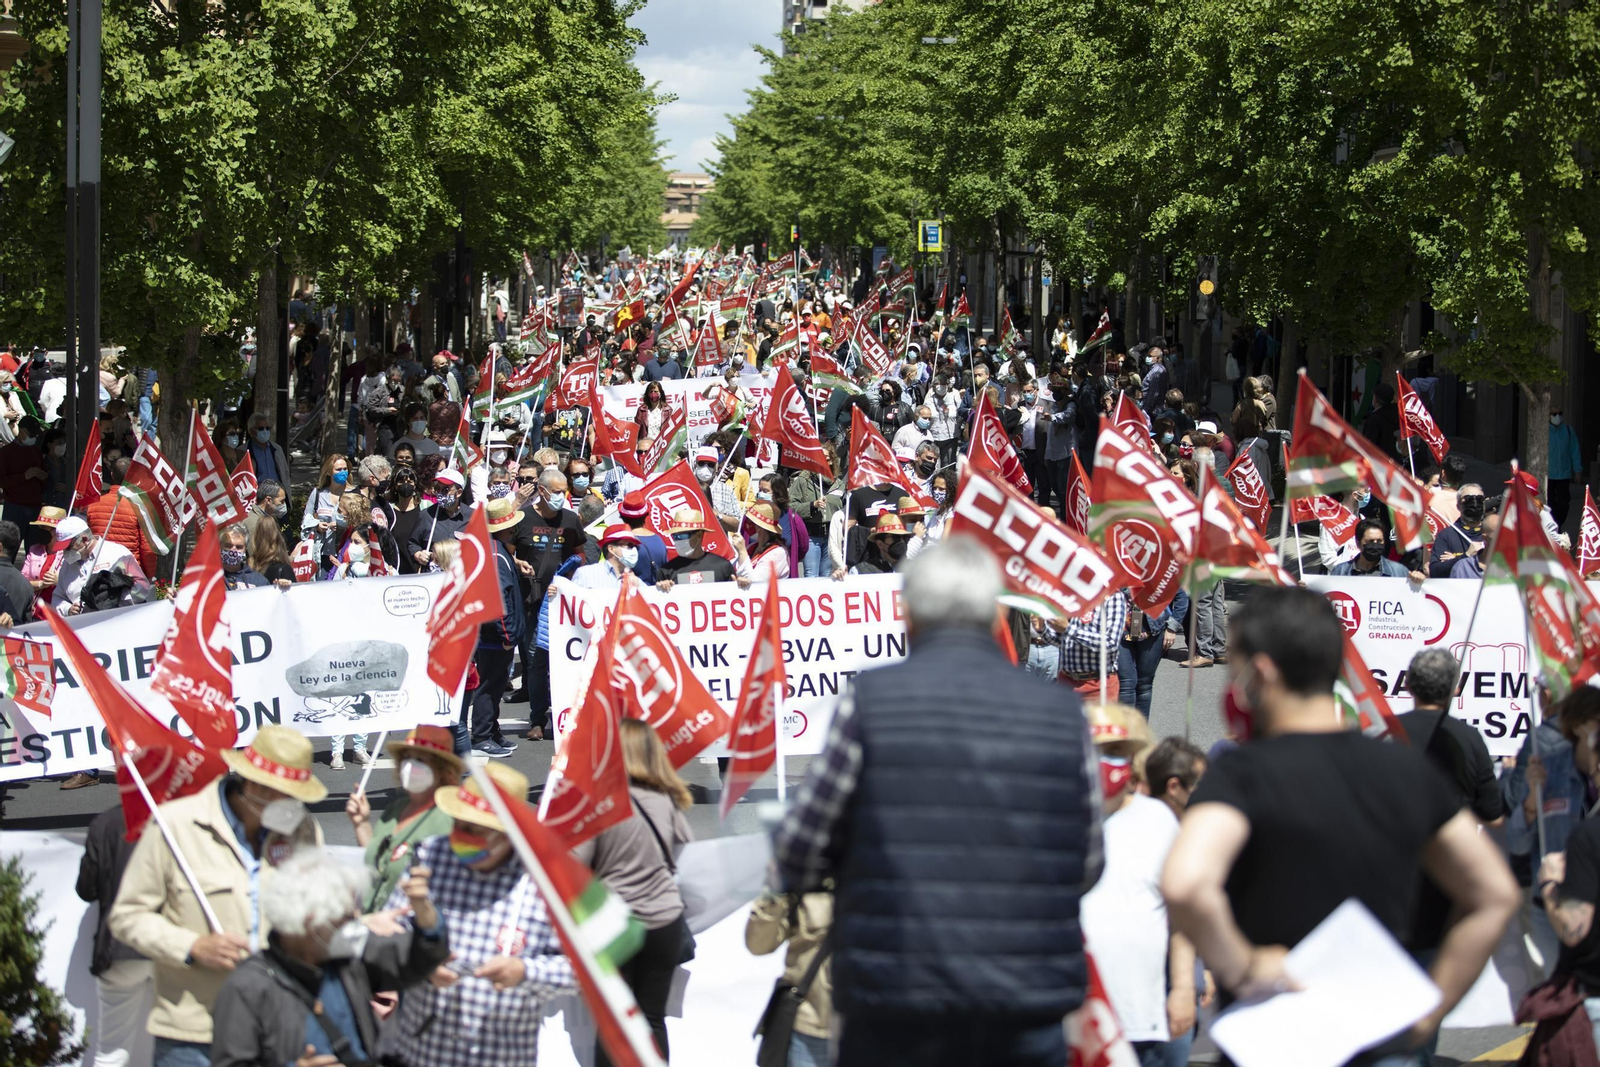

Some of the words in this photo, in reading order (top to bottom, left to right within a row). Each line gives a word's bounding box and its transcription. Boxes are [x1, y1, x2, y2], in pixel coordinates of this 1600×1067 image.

[985, 418, 1017, 467] UGT
[132, 439, 197, 525] CCOO
[955, 474, 1114, 601] CCOO
[1114, 523, 1158, 571] UGT
[559, 593, 596, 629] NO
[691, 593, 835, 633] DESPDOS
[845, 591, 881, 624] EN
[892, 590, 903, 621] E
[1331, 600, 1355, 622] GT
[1369, 601, 1404, 616] FICA
[1368, 623, 1409, 631] Construcción
[1417, 625, 1432, 633] Agro
[1368, 632, 1413, 640] GRANADA
[781, 637, 836, 664] BVA
[864, 632, 906, 658] UN
[300, 675, 319, 686] Ley
[323, 674, 338, 683] de
[341, 672, 351, 681] la
[355, 669, 397, 681] Ciencia
[329, 659, 366, 670] Nueva
[786, 670, 857, 699] SANT
